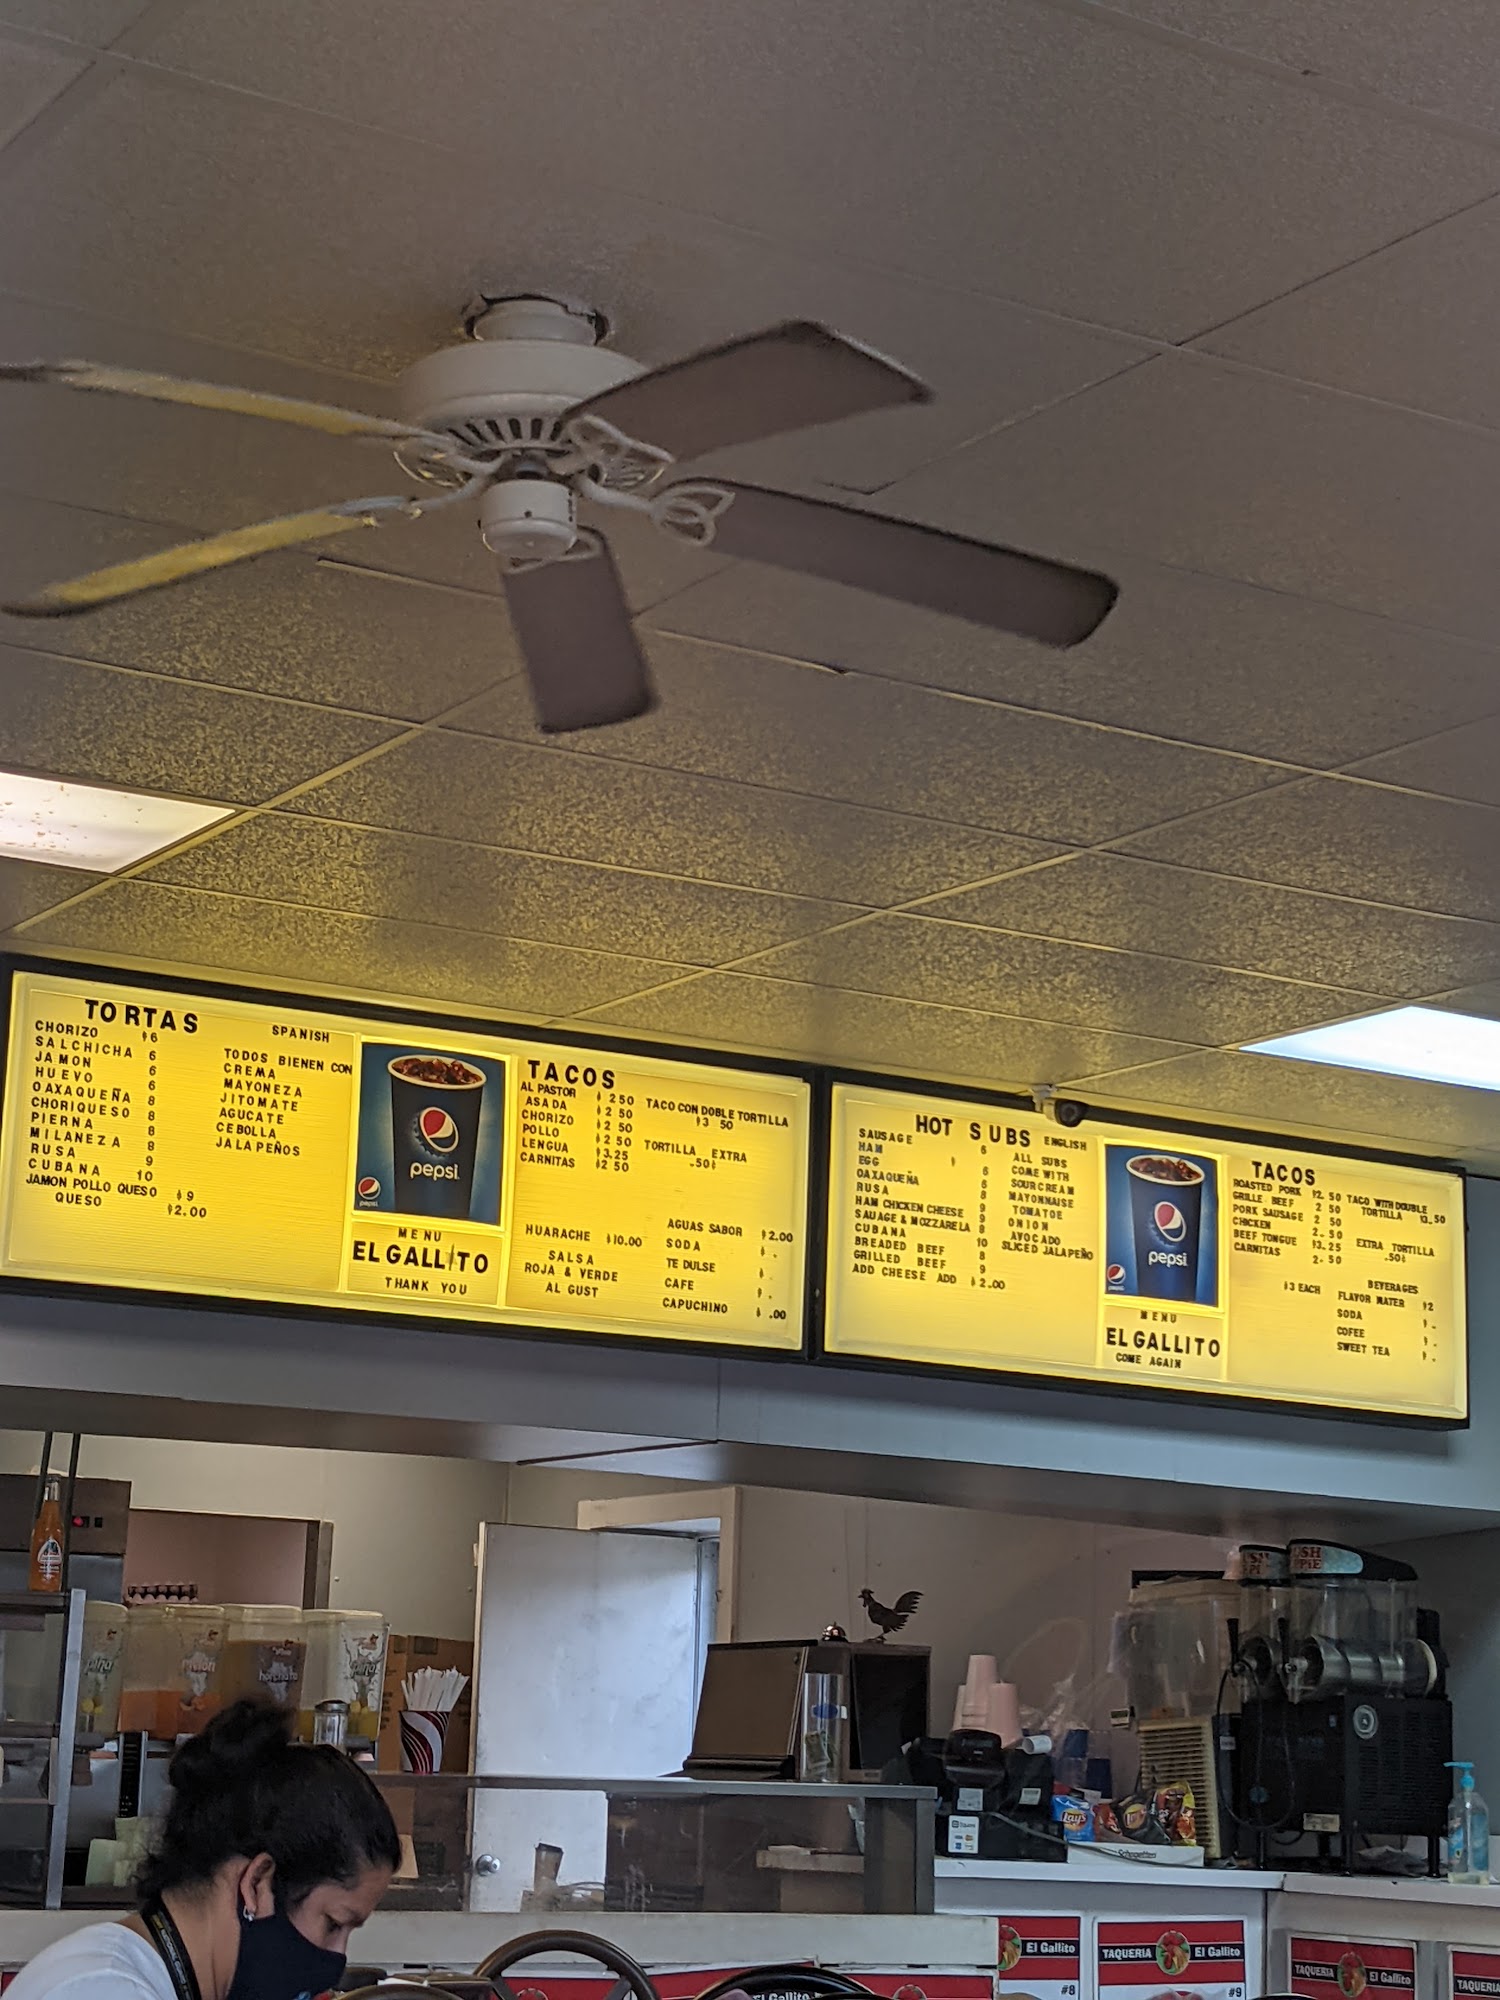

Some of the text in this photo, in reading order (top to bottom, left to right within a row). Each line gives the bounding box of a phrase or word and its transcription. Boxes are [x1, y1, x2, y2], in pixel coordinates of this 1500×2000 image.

[85, 999, 198, 1033] TORTAS
[35, 1020, 98, 1037] CHORIZO
[272, 1025, 330, 1042] SPANISH
[35, 1036, 156, 1061] SALCHICHA 6
[35, 1051, 156, 1076] JAMON 6
[224, 1048, 352, 1075] TODOS BIENEN CON
[36, 1067, 155, 1091] HUEVO 6
[224, 1063, 276, 1079] CREMA
[528, 1060, 615, 1089] TACOS
[32, 1082, 155, 1106] OAXAQUEÑA 8
[224, 1078, 302, 1097] MAYONEZA
[521, 1081, 576, 1098] AL PASTOR
[31, 1097, 130, 1118] CHORIQUESO
[220, 1092, 298, 1112] JITOMATE
[526, 1096, 567, 1110] ASADA
[31, 1112, 93, 1129] PIERNA
[219, 1107, 284, 1124] AGUCATE
[522, 1109, 574, 1125] CHORIZO
[646, 1098, 788, 1127] TACO CON DOBLE TORTILLA
[30, 1127, 120, 1147] MILANEZA
[216, 1122, 276, 1139] CEBOLLA
[522, 1123, 559, 1138] POLLO
[859, 1128, 912, 1144] SAUSAGE
[916, 1114, 1031, 1148] HOT SUBS
[31, 1143, 75, 1158] RUSA
[216, 1136, 300, 1156] JALAPEÑOS
[522, 1138, 568, 1153] LENGUA
[644, 1140, 747, 1163] TORTILLA EXTRA
[858, 1141, 883, 1154] HAM
[1044, 1136, 1087, 1151] ENGLISH
[520, 1152, 575, 1168] CARNITAS
[858, 1155, 879, 1166] EGG
[1013, 1152, 1067, 1168] ALL SUBS
[28, 1158, 153, 1181] CUBANA 10
[410, 1162, 460, 1181] pepsi
[1012, 1166, 1070, 1182] COME WITH
[1252, 1161, 1315, 1186] TACOS
[26, 1174, 157, 1197] JAMON POLLO QUESO
[856, 1182, 889, 1195] RUSA
[1011, 1179, 1074, 1195] SOUR CREAM
[1233, 1179, 1301, 1196] ROASTED PORK
[55, 1192, 102, 1207] QUESO
[855, 1195, 964, 1218] HAM CHICKEN CHEESE
[1233, 1191, 1294, 1207] GRILLE BEEF
[1347, 1195, 1369, 1205] TACO
[1395, 1202, 1427, 1214] DOUBLE
[1012, 1205, 1063, 1220] TOMATOE
[1233, 1204, 1303, 1222] PORK SAUSAGE
[1361, 1207, 1402, 1221] TORTILLA
[526, 1224, 591, 1241] HUARACHE
[667, 1218, 742, 1236] AGUAS SABOR
[855, 1223, 906, 1237] CUBANA
[1008, 1218, 1048, 1231] ONION
[398, 1227, 441, 1242] MENU
[1011, 1231, 1061, 1245] AVOCADO
[1233, 1229, 1297, 1246] BEEF TONGUE
[666, 1238, 700, 1251] SODA
[855, 1236, 945, 1255] BREADED BEEF
[1002, 1241, 1093, 1260] SLICED JALAPEÑO
[1234, 1242, 1281, 1256] CARNITAS
[1356, 1238, 1434, 1256] EXTRA TORTILLA
[548, 1250, 593, 1265] SALSA
[666, 1258, 716, 1272] TE DULSE
[854, 1250, 946, 1269] GRILLED BEEF
[1148, 1251, 1188, 1268] pepsi
[525, 1262, 618, 1281] ROJA VERDE
[852, 1263, 956, 1284] ADD CHEESE ADD
[385, 1277, 467, 1295] THANK YOU
[546, 1282, 598, 1298] AL GUST
[665, 1278, 694, 1290] CAFE
[1298, 1283, 1321, 1294] EACH
[1367, 1280, 1418, 1294] BEVERAGES
[662, 1298, 728, 1313] CAPUCHINO
[1338, 1291, 1405, 1307] FLAVOR WATER
[1140, 1310, 1177, 1323] MENU
[1337, 1308, 1362, 1320] SODA
[1336, 1326, 1365, 1338] COFEE
[1133, 1331, 1220, 1357] GALLITO
[1337, 1342, 1390, 1356] SWEET TEA
[1116, 1353, 1181, 1368] COME AGAIN
[1061, 1812, 1087, 1824] Lay's
[1026, 1941, 1075, 1954] El Gallito
[1102, 1944, 1240, 1960] TAQUERIA El Gallito
[1295, 1965, 1411, 1985] TAQUERIA El Gallito
[1061, 1985, 1075, 1995] #8
[1228, 1987, 1242, 1998] #9
